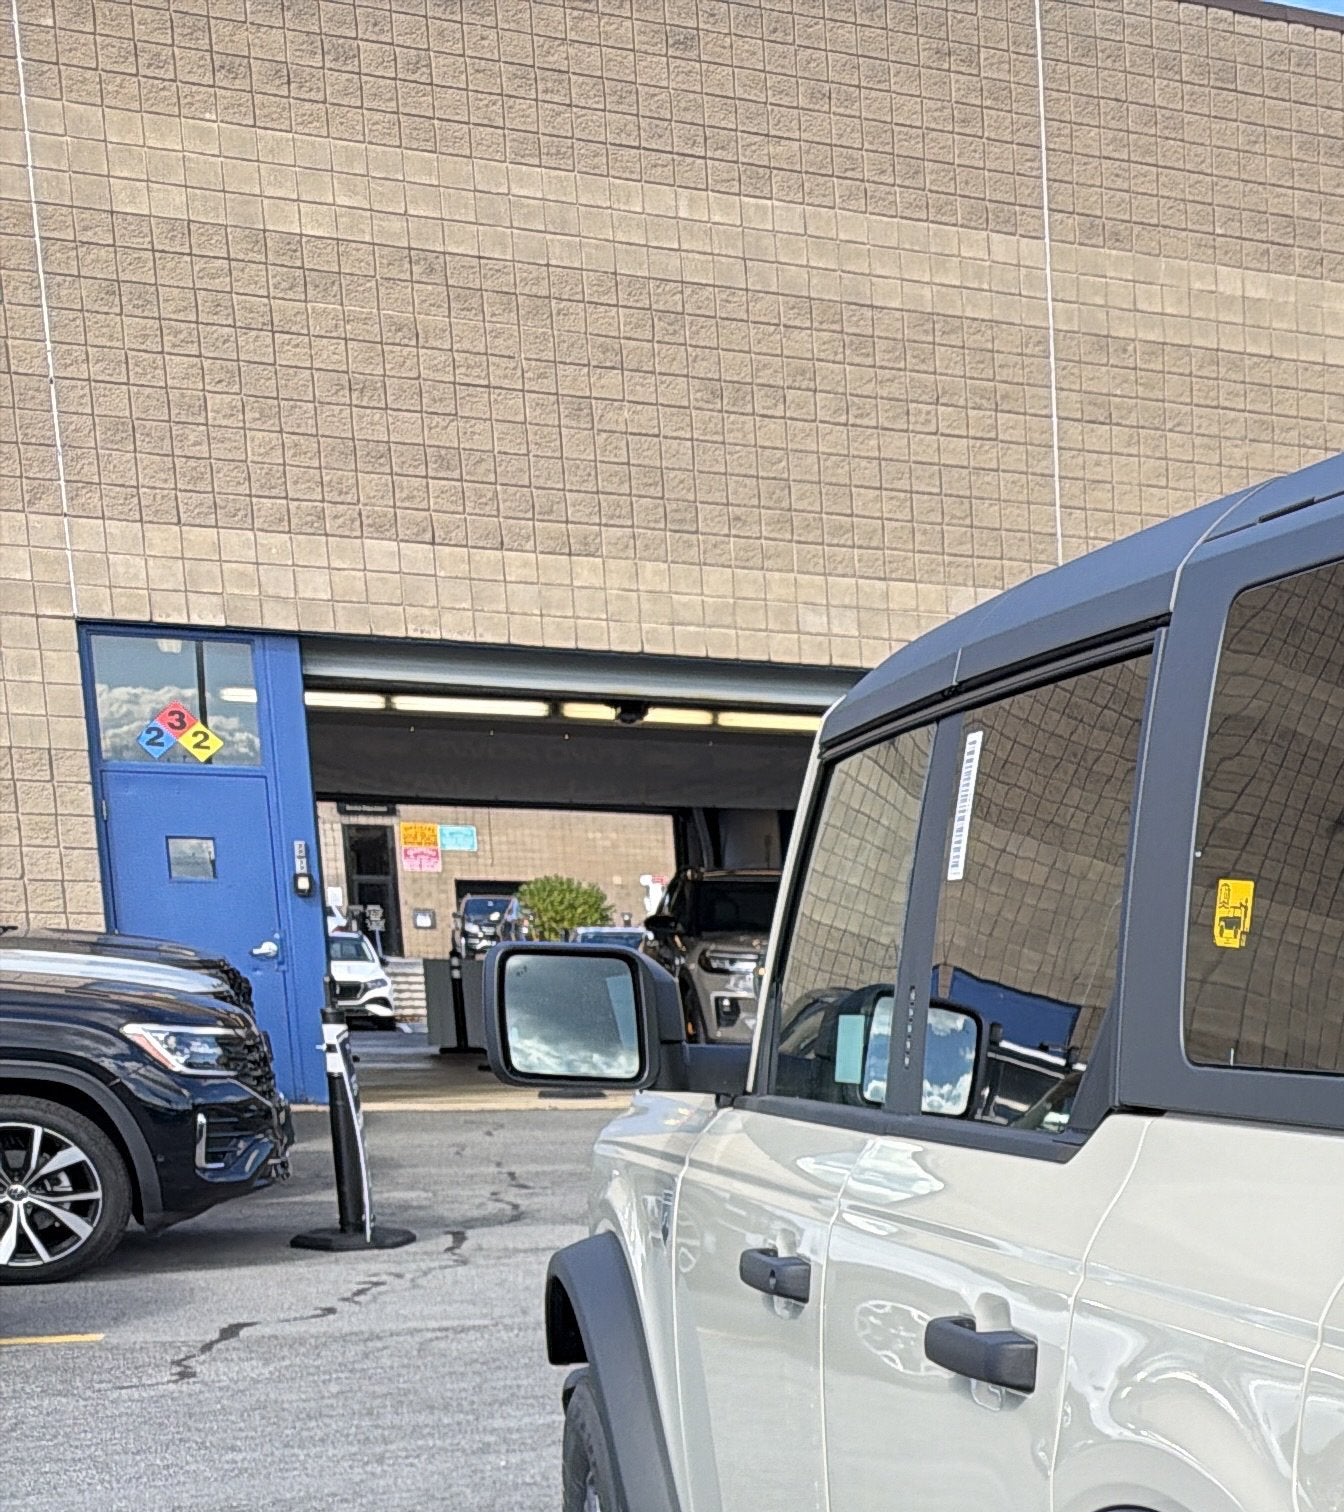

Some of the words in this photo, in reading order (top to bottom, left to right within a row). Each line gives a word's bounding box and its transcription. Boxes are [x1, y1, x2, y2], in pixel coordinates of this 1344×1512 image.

[168, 710, 187, 731] 3
[145, 727, 165, 747] 2
[192, 731, 211, 750] 2
